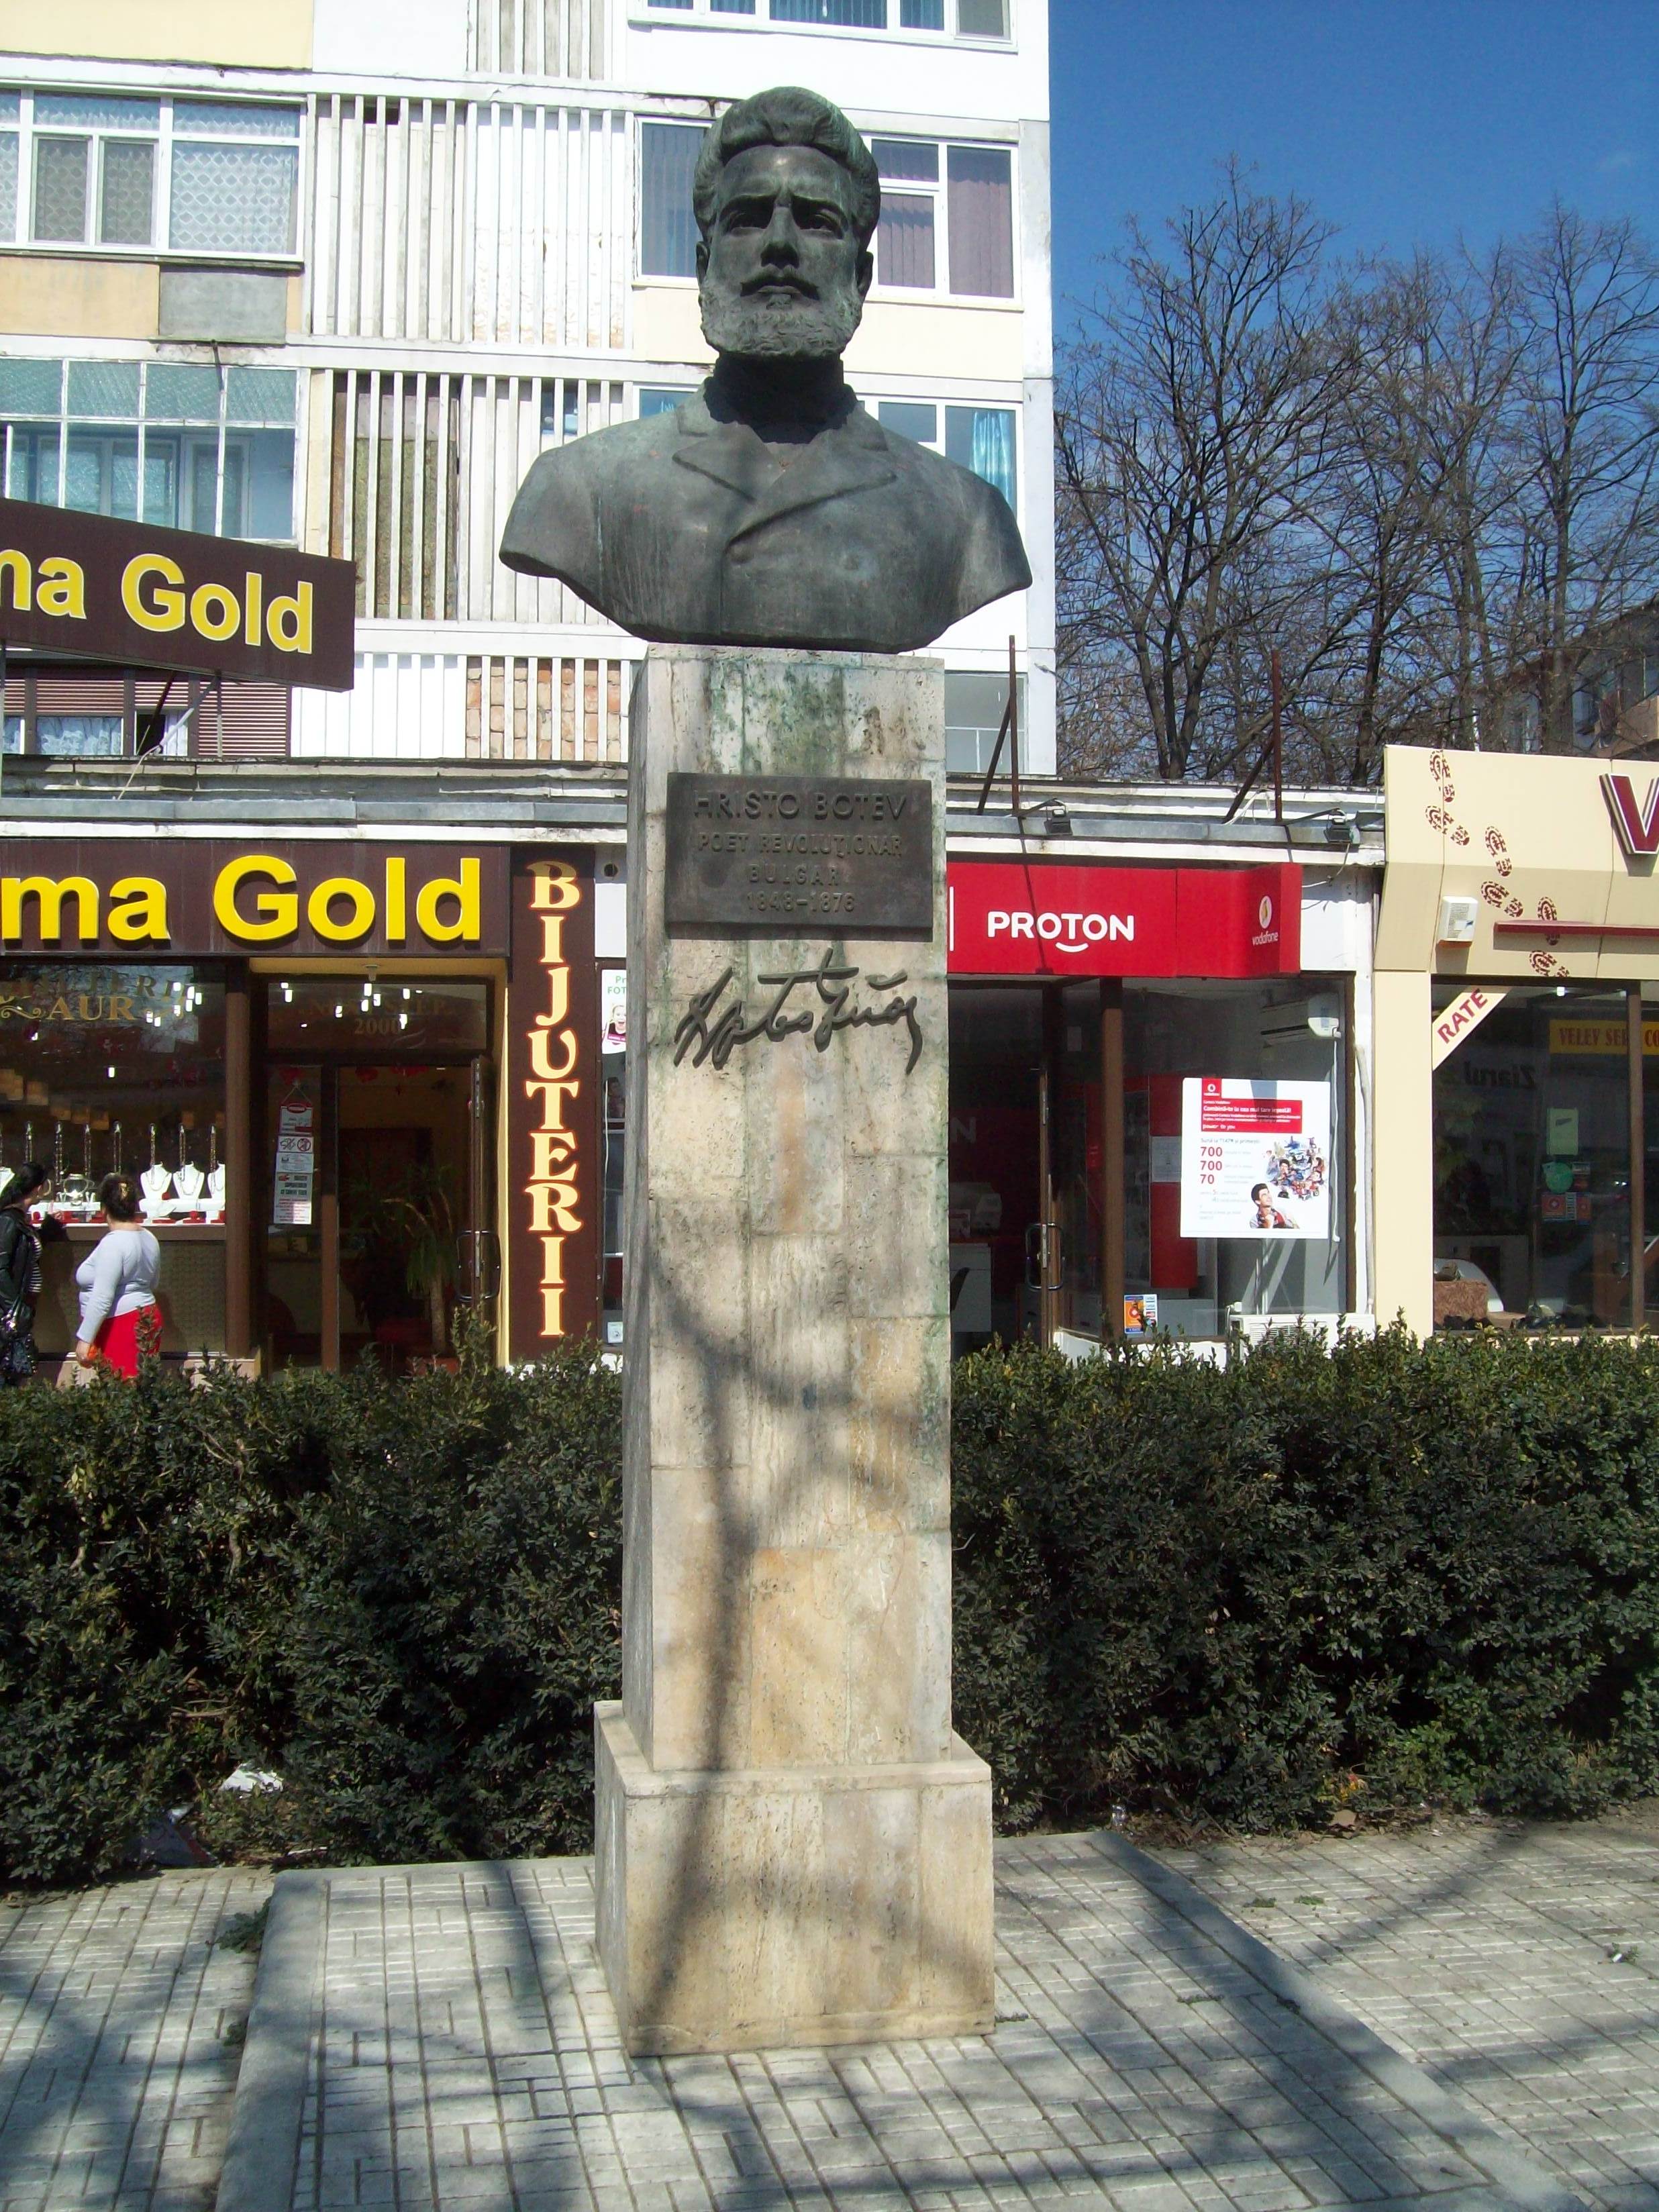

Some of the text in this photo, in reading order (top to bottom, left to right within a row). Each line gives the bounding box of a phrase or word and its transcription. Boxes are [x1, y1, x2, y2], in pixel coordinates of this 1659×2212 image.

[121, 553, 314, 655] Gold
[693, 790, 907, 821] HRISTO BOTEV
[697, 832, 749, 853] POET
[748, 863, 840, 887] BULGAR
[213, 854, 481, 942] Gold
[987, 911, 1134, 941] PROTON
[1252, 931, 1278, 946] vodafone
[45, 996, 140, 1021] AUR
[1437, 989, 1489, 1044] RATE
[525, 860, 583, 1336] BIJUTERII
[1200, 1146, 1223, 1157] 700
[1200, 1160, 1223, 1170] 700
[1200, 1174, 1215, 1185] 70
